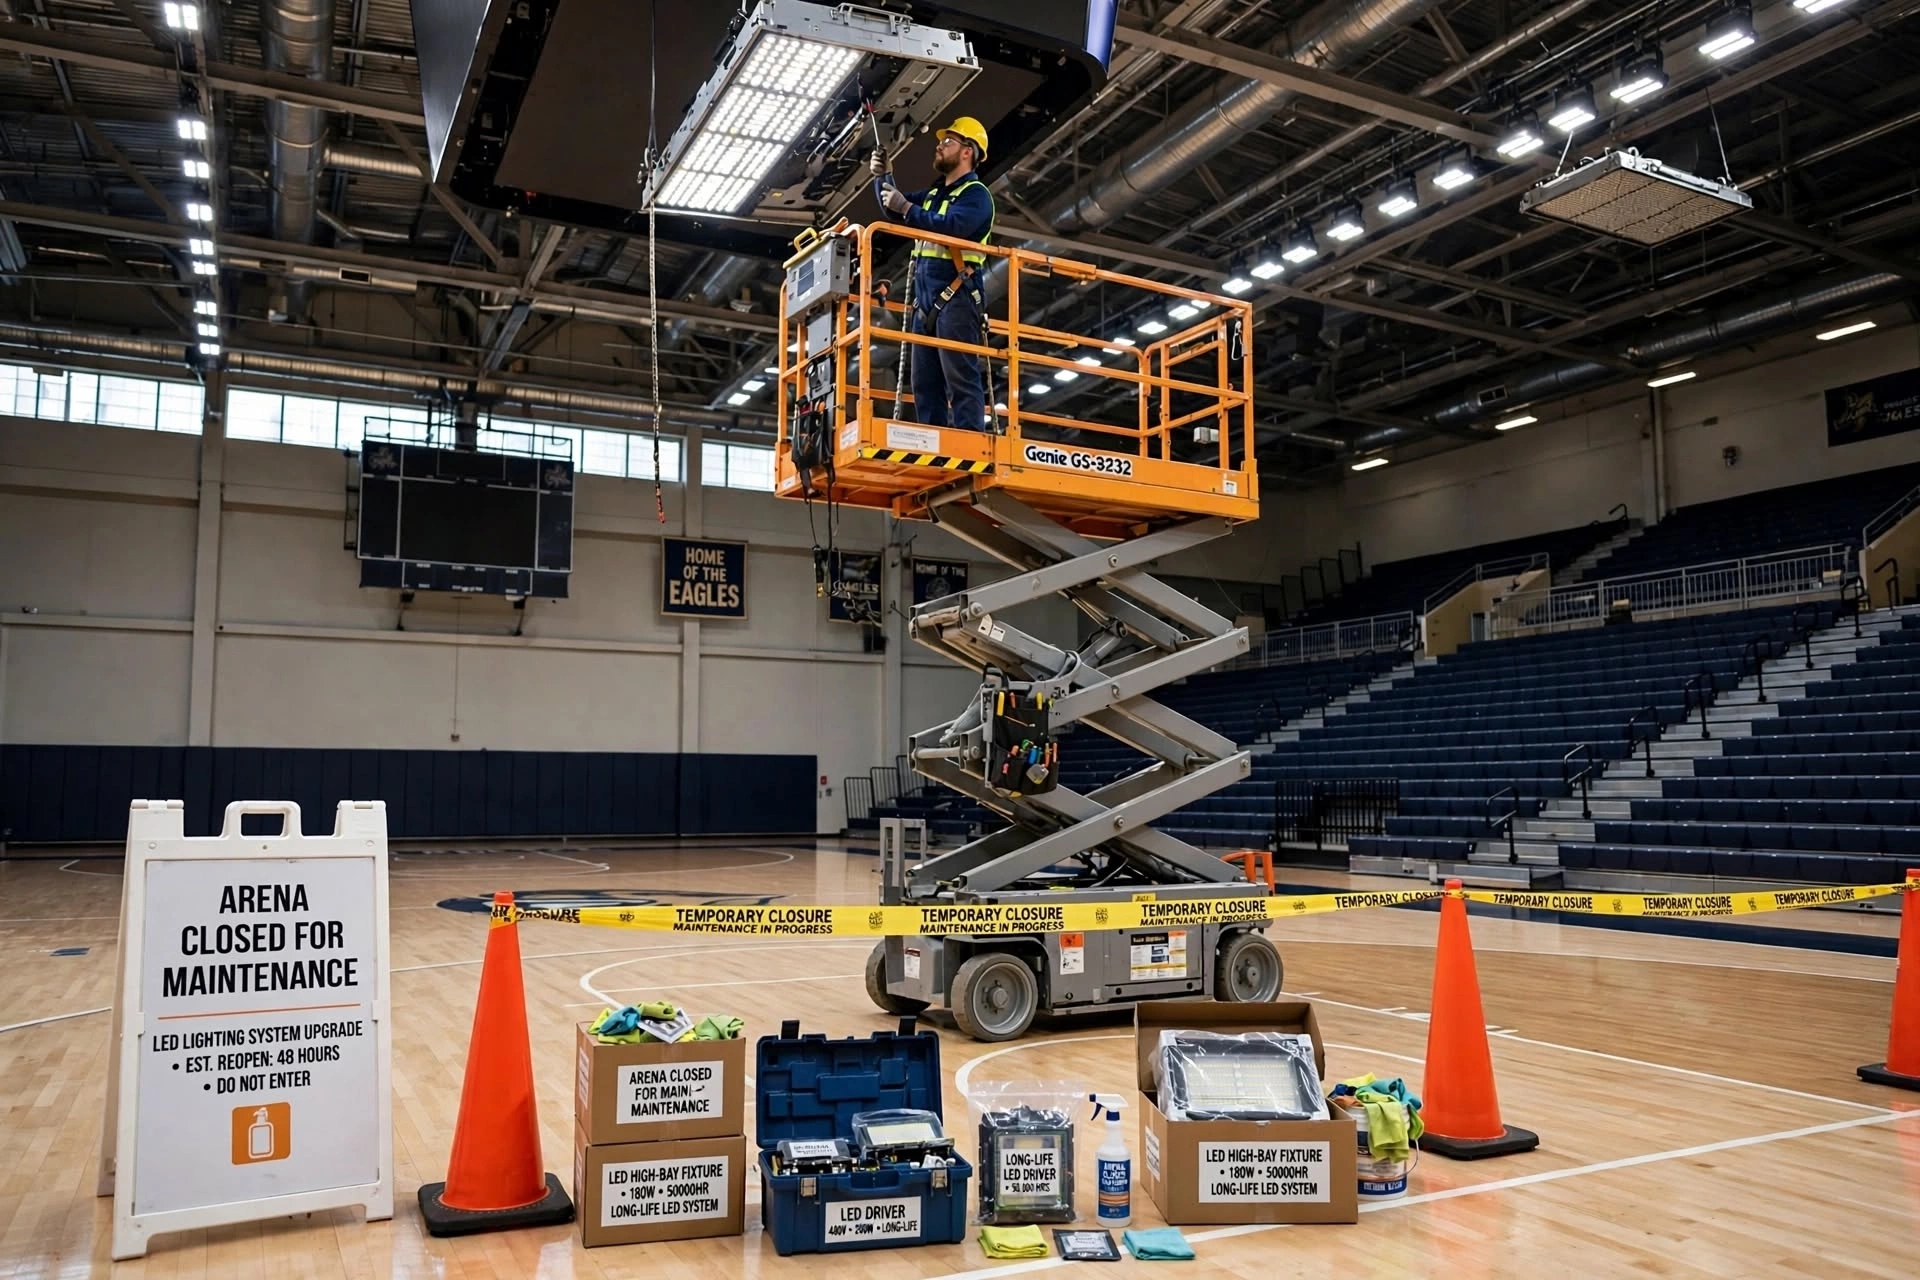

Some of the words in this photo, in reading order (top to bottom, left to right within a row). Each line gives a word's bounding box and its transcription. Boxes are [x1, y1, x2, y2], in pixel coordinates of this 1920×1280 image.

[1025, 445, 1067, 466] Genie
[1070, 452, 1131, 476] GS-3232
[685, 547, 725, 565] HOME
[683, 565, 699, 580] OF
[702, 566, 727, 582] THE
[669, 579, 740, 608] EAGLES
[219, 884, 309, 914] ARENA
[1335, 892, 1398, 909] TEMPORARY
[1493, 893, 1550, 908] TEMPORARY
[1552, 896, 1593, 909] CLOSURE
[1643, 897, 1693, 909] TEMPORARY
[1695, 896, 1732, 909] CLOSURE
[1774, 891, 1819, 905] TEMPORARY
[1821, 888, 1855, 903] CLOSURE
[676, 908, 765, 922] TEMPORARY
[768, 909, 832, 923] CLOSURE
[921, 907, 1002, 922] TEMPORARY
[1005, 906, 1063, 920] CLOSURE
[1141, 902, 1212, 917] TEMPORARY
[1215, 900, 1266, 914] CLOSURE
[673, 922, 758, 934] MAINTENANCE
[760, 924, 772, 934] IN
[774, 924, 833, 934] PROGRESS
[919, 922, 996, 933] MAINTENANCE
[998, 922, 1009, 932] IN
[1012, 921, 1065, 932] PROGRESS
[1140, 916, 1207, 926] MAINTENANCE
[1209, 915, 1218, 923] IN
[181, 923, 286, 956] CLOSED
[295, 920, 344, 951] FOR
[162, 957, 359, 998] MAINTENANCE
[152, 1034, 179, 1052] LED
[182, 1029, 245, 1050] LIGHTING
[248, 1025, 301, 1045] SYSTEM
[304, 1020, 363, 1041] UPGRADE
[186, 1055, 213, 1074] EST.
[217, 1050, 274, 1071] REOPEN:
[277, 1048, 295, 1066] 48
[298, 1044, 340, 1064] HOURS
[217, 1076, 236, 1095] DO
[239, 1074, 266, 1093] NOT
[269, 1070, 311, 1090] ENTER
[629, 1069, 667, 1085] ARENA
[669, 1067, 712, 1082] CLOSED
[635, 1086, 657, 1101] FOR
[631, 1099, 710, 1117] MAINTENANCE
[1006, 1153, 1054, 1166] LONG-LIFE
[1206, 1149, 1226, 1162] LED
[1228, 1148, 1278, 1163] HIGH-BAY
[1280, 1149, 1323, 1163] FIXTURE
[609, 1170, 628, 1185] LED
[630, 1166, 680, 1183] HIGH-BAY
[682, 1163, 723, 1180] FIXTURE
[1003, 1168, 1021, 1181] LED
[1023, 1167, 1056, 1181] DRIVER
[1229, 1166, 1255, 1179] 180W
[1266, 1166, 1309, 1179] 50000HR
[629, 1185, 656, 1200] 180W
[667, 1181, 710, 1197] 50000HR
[1211, 1182, 1259, 1195] LONG-LIFE
[1261, 1182, 1279, 1195] LED
[1280, 1182, 1318, 1195] SYSTEM
[611, 1202, 660, 1218] LONG-LIFE
[662, 1201, 681, 1215] LED
[682, 1198, 719, 1214] SYSTEM
[841, 1207, 862, 1221] LED
[865, 1204, 906, 1220] DRIVER
[881, 1220, 918, 1233] LONG-LIFE
